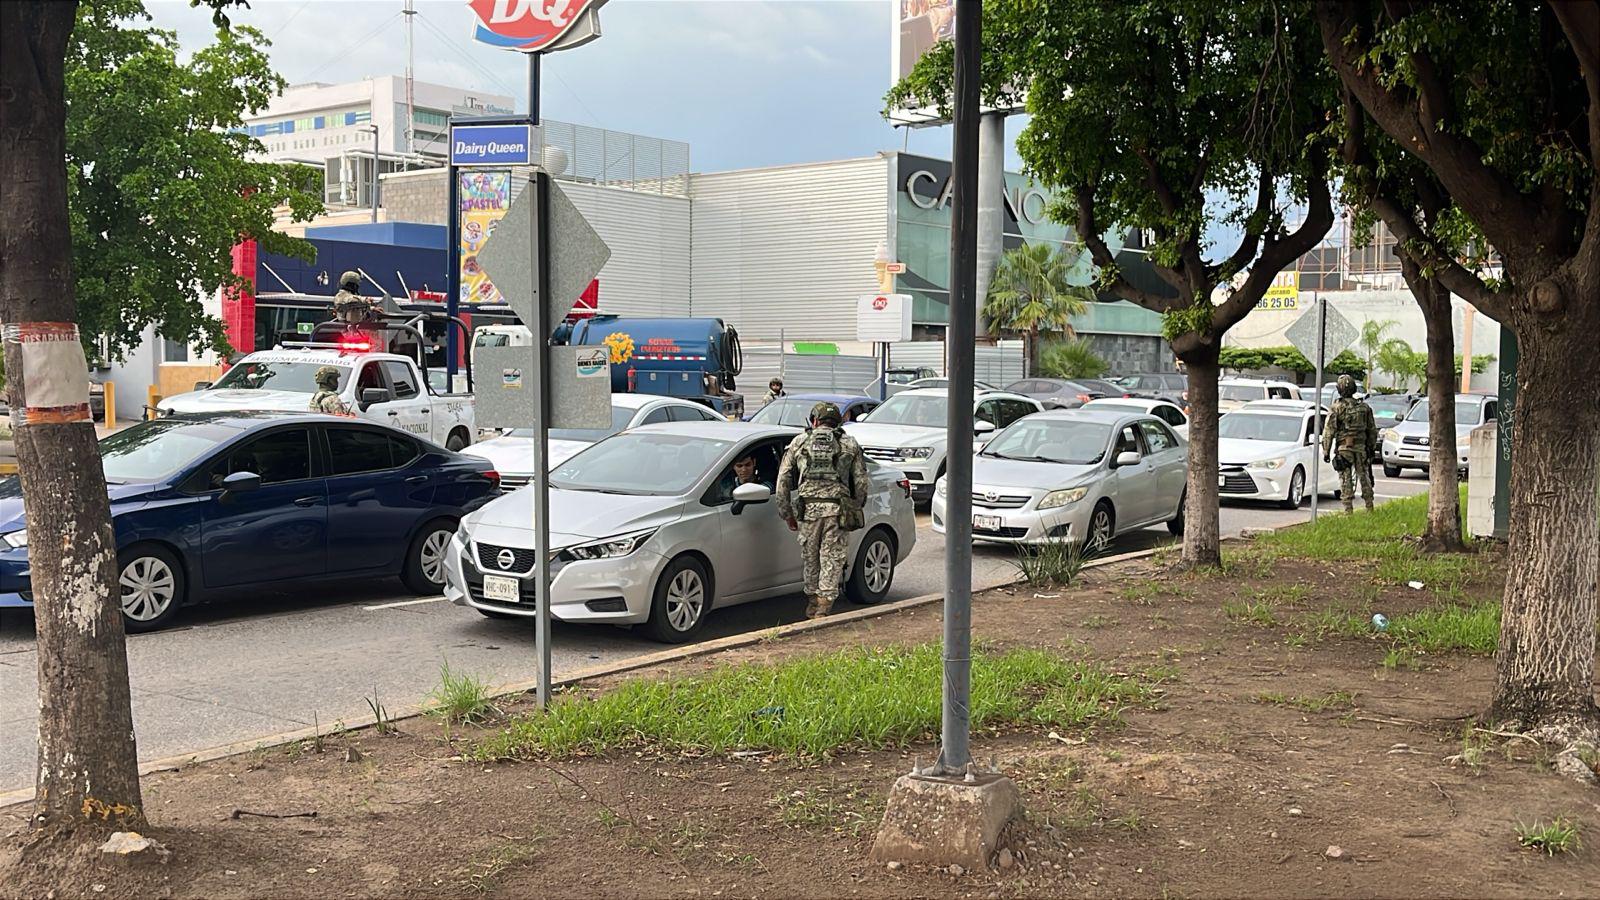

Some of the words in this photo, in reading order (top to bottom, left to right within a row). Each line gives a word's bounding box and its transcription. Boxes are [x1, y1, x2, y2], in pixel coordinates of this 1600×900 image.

[490, 0, 567, 27] DQ
[455, 141, 486, 157] Dairy
[488, 142, 523, 154] Queen
[1271, 298, 1281, 308] 25
[1284, 297, 1295, 307] 05
